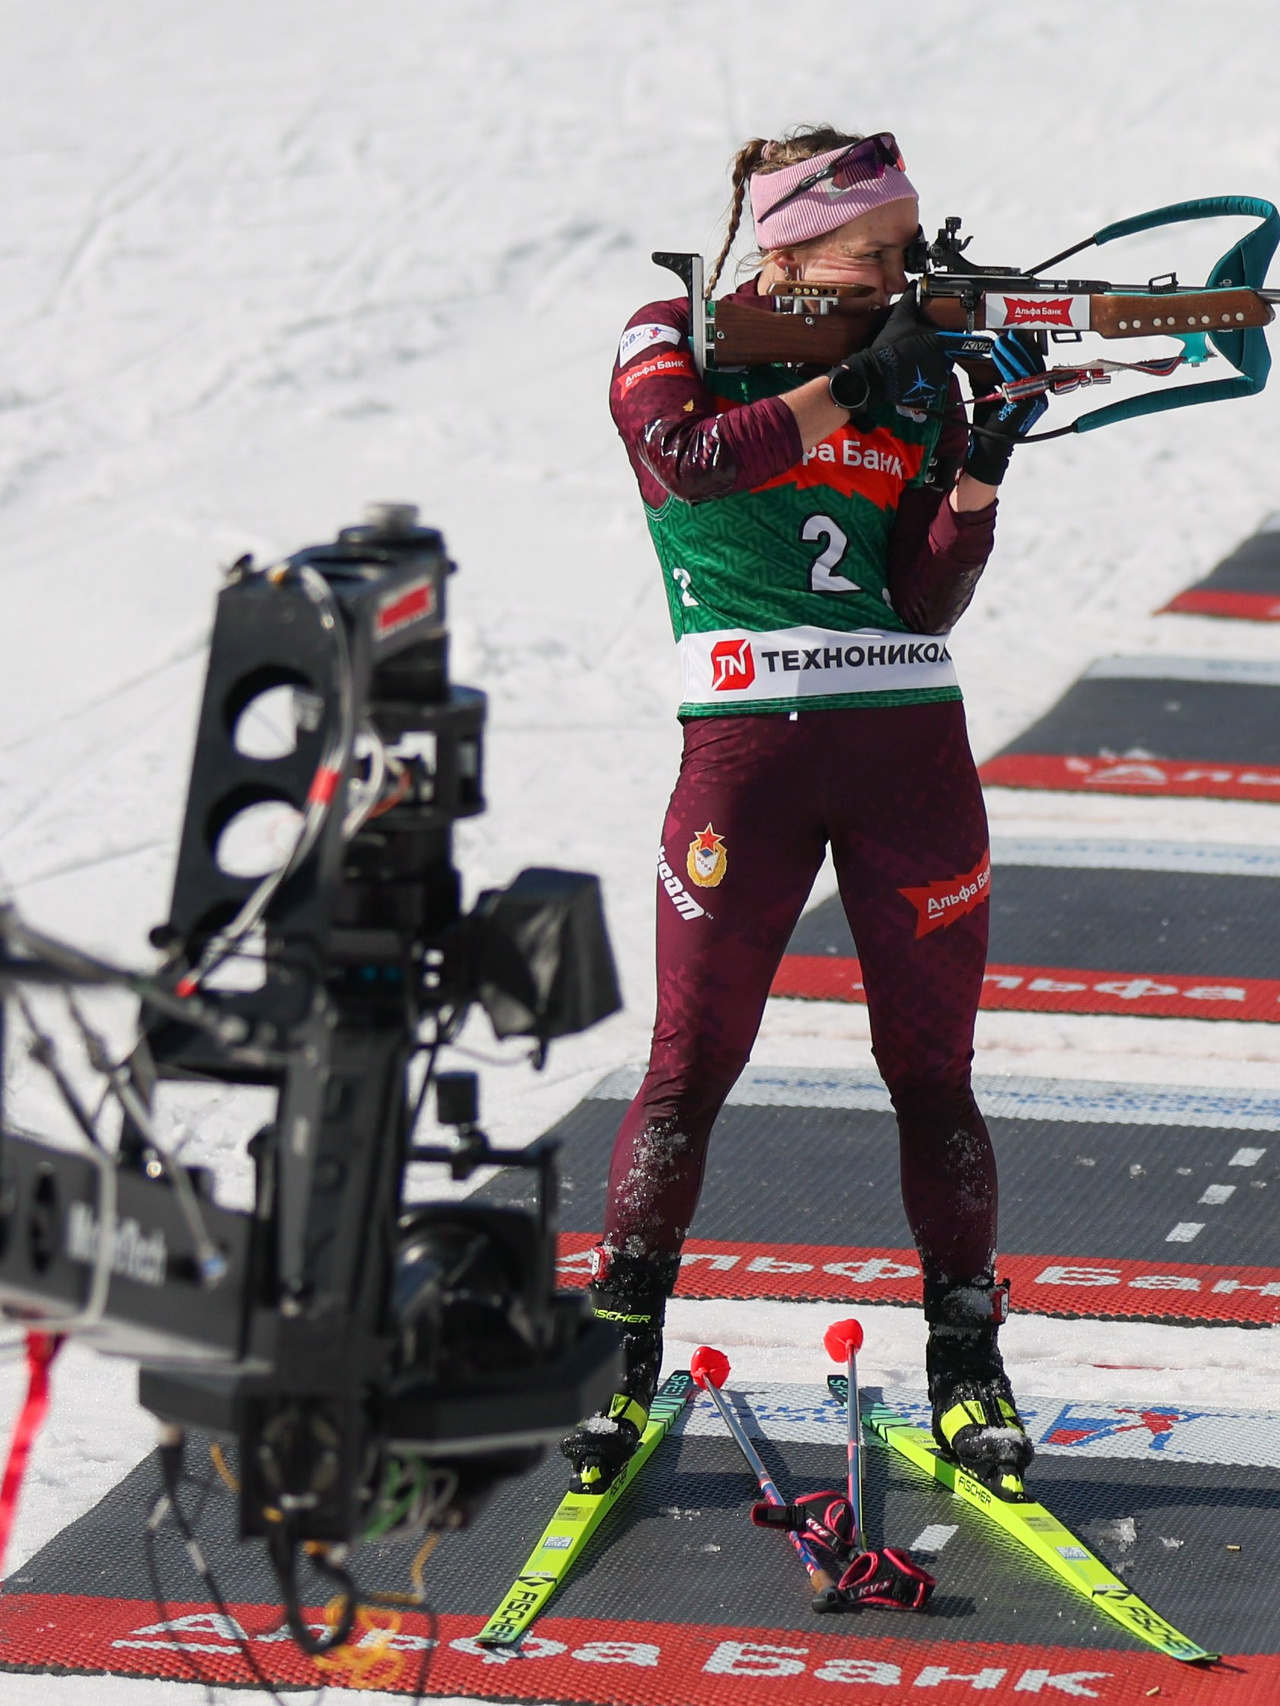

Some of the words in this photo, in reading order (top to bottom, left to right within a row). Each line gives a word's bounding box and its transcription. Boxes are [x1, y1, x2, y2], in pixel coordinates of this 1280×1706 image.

[1014, 306, 1041, 317] Альфа
[1041, 307, 1062, 315] Банк
[624, 364, 656, 388] Альфа
[656, 360, 684, 371] Банк
[843, 439, 904, 480] Банк
[801, 514, 863, 592] 2
[672, 567, 699, 607] 2
[927, 883, 978, 919] Альфа
[957, 1475, 992, 1508] FISCHER
[701, 1640, 1114, 1699] Банк
